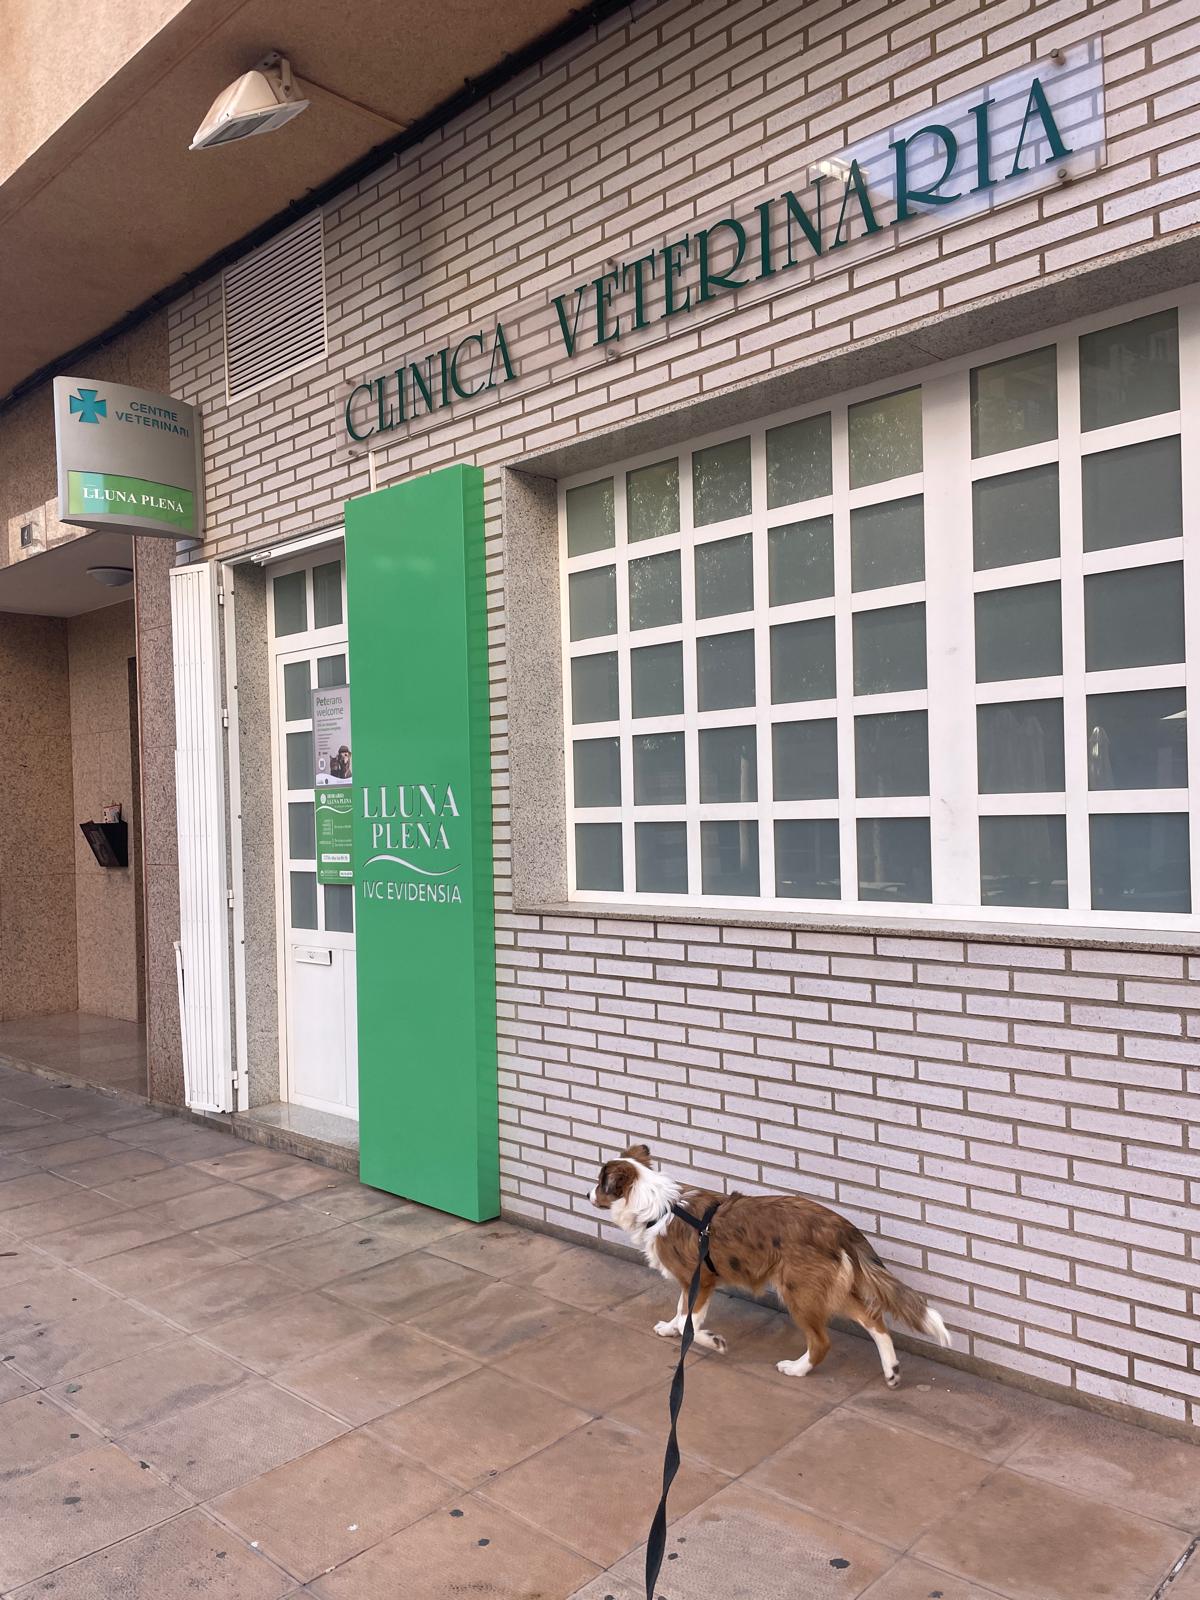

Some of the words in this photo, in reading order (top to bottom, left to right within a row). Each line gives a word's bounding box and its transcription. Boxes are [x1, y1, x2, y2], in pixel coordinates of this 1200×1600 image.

[345, 322, 517, 441] CLINICA
[551, 77, 1072, 358] VETERINARIA
[115, 411, 189, 438] VETERINARI
[130, 401, 178, 422] CENTRE
[83, 487, 137, 504] LLUNA
[141, 494, 184, 513] PLENA
[316, 697, 342, 706] Peterans
[316, 707, 344, 717] welcome
[362, 784, 460, 818] LLUNA
[371, 822, 450, 849] PLENA
[363, 880, 384, 899] IVC
[387, 881, 462, 903] EVIDENSIA
